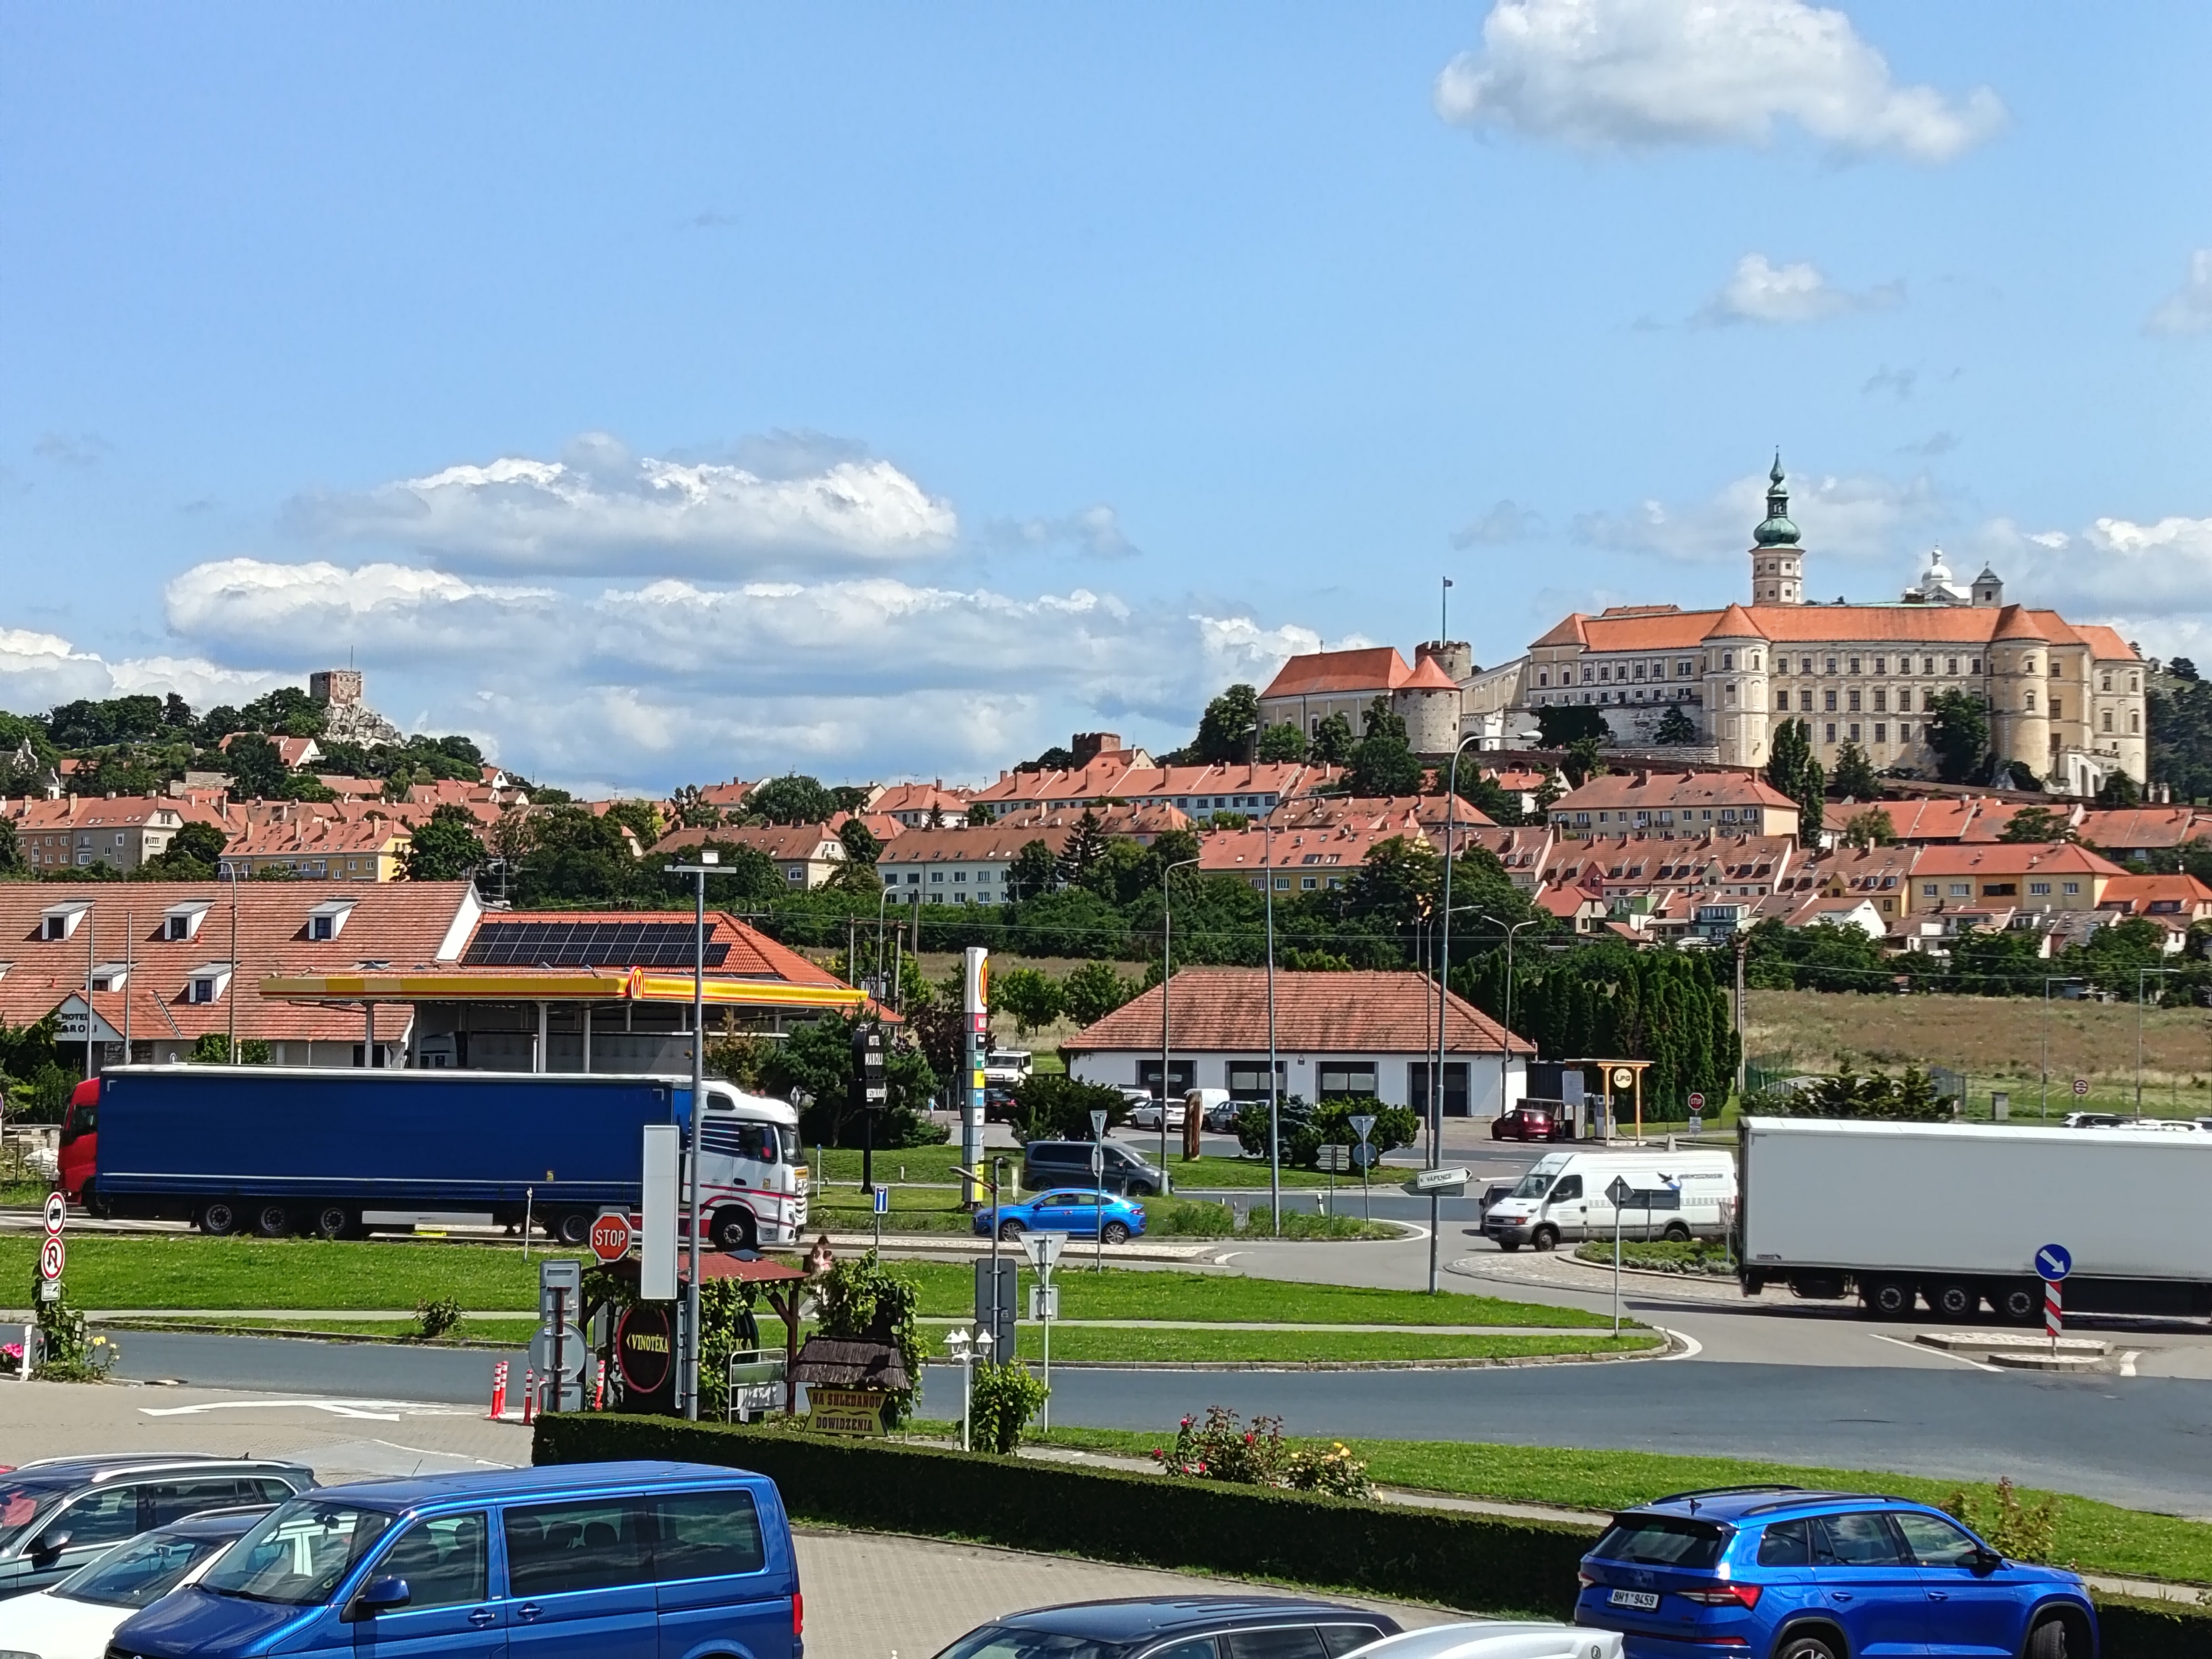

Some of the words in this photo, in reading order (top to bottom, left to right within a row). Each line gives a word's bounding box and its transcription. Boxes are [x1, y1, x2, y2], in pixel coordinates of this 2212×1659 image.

[633, 975, 641, 997] M
[595, 1229, 625, 1247] STOP
[632, 1333, 669, 1353] VINOTÉKA
[812, 1392, 825, 1405] NA
[827, 1393, 881, 1408] SHLEDANOU
[816, 1416, 873, 1432] DOWIDZENIA
[1634, 1594, 1655, 1606] 9459
